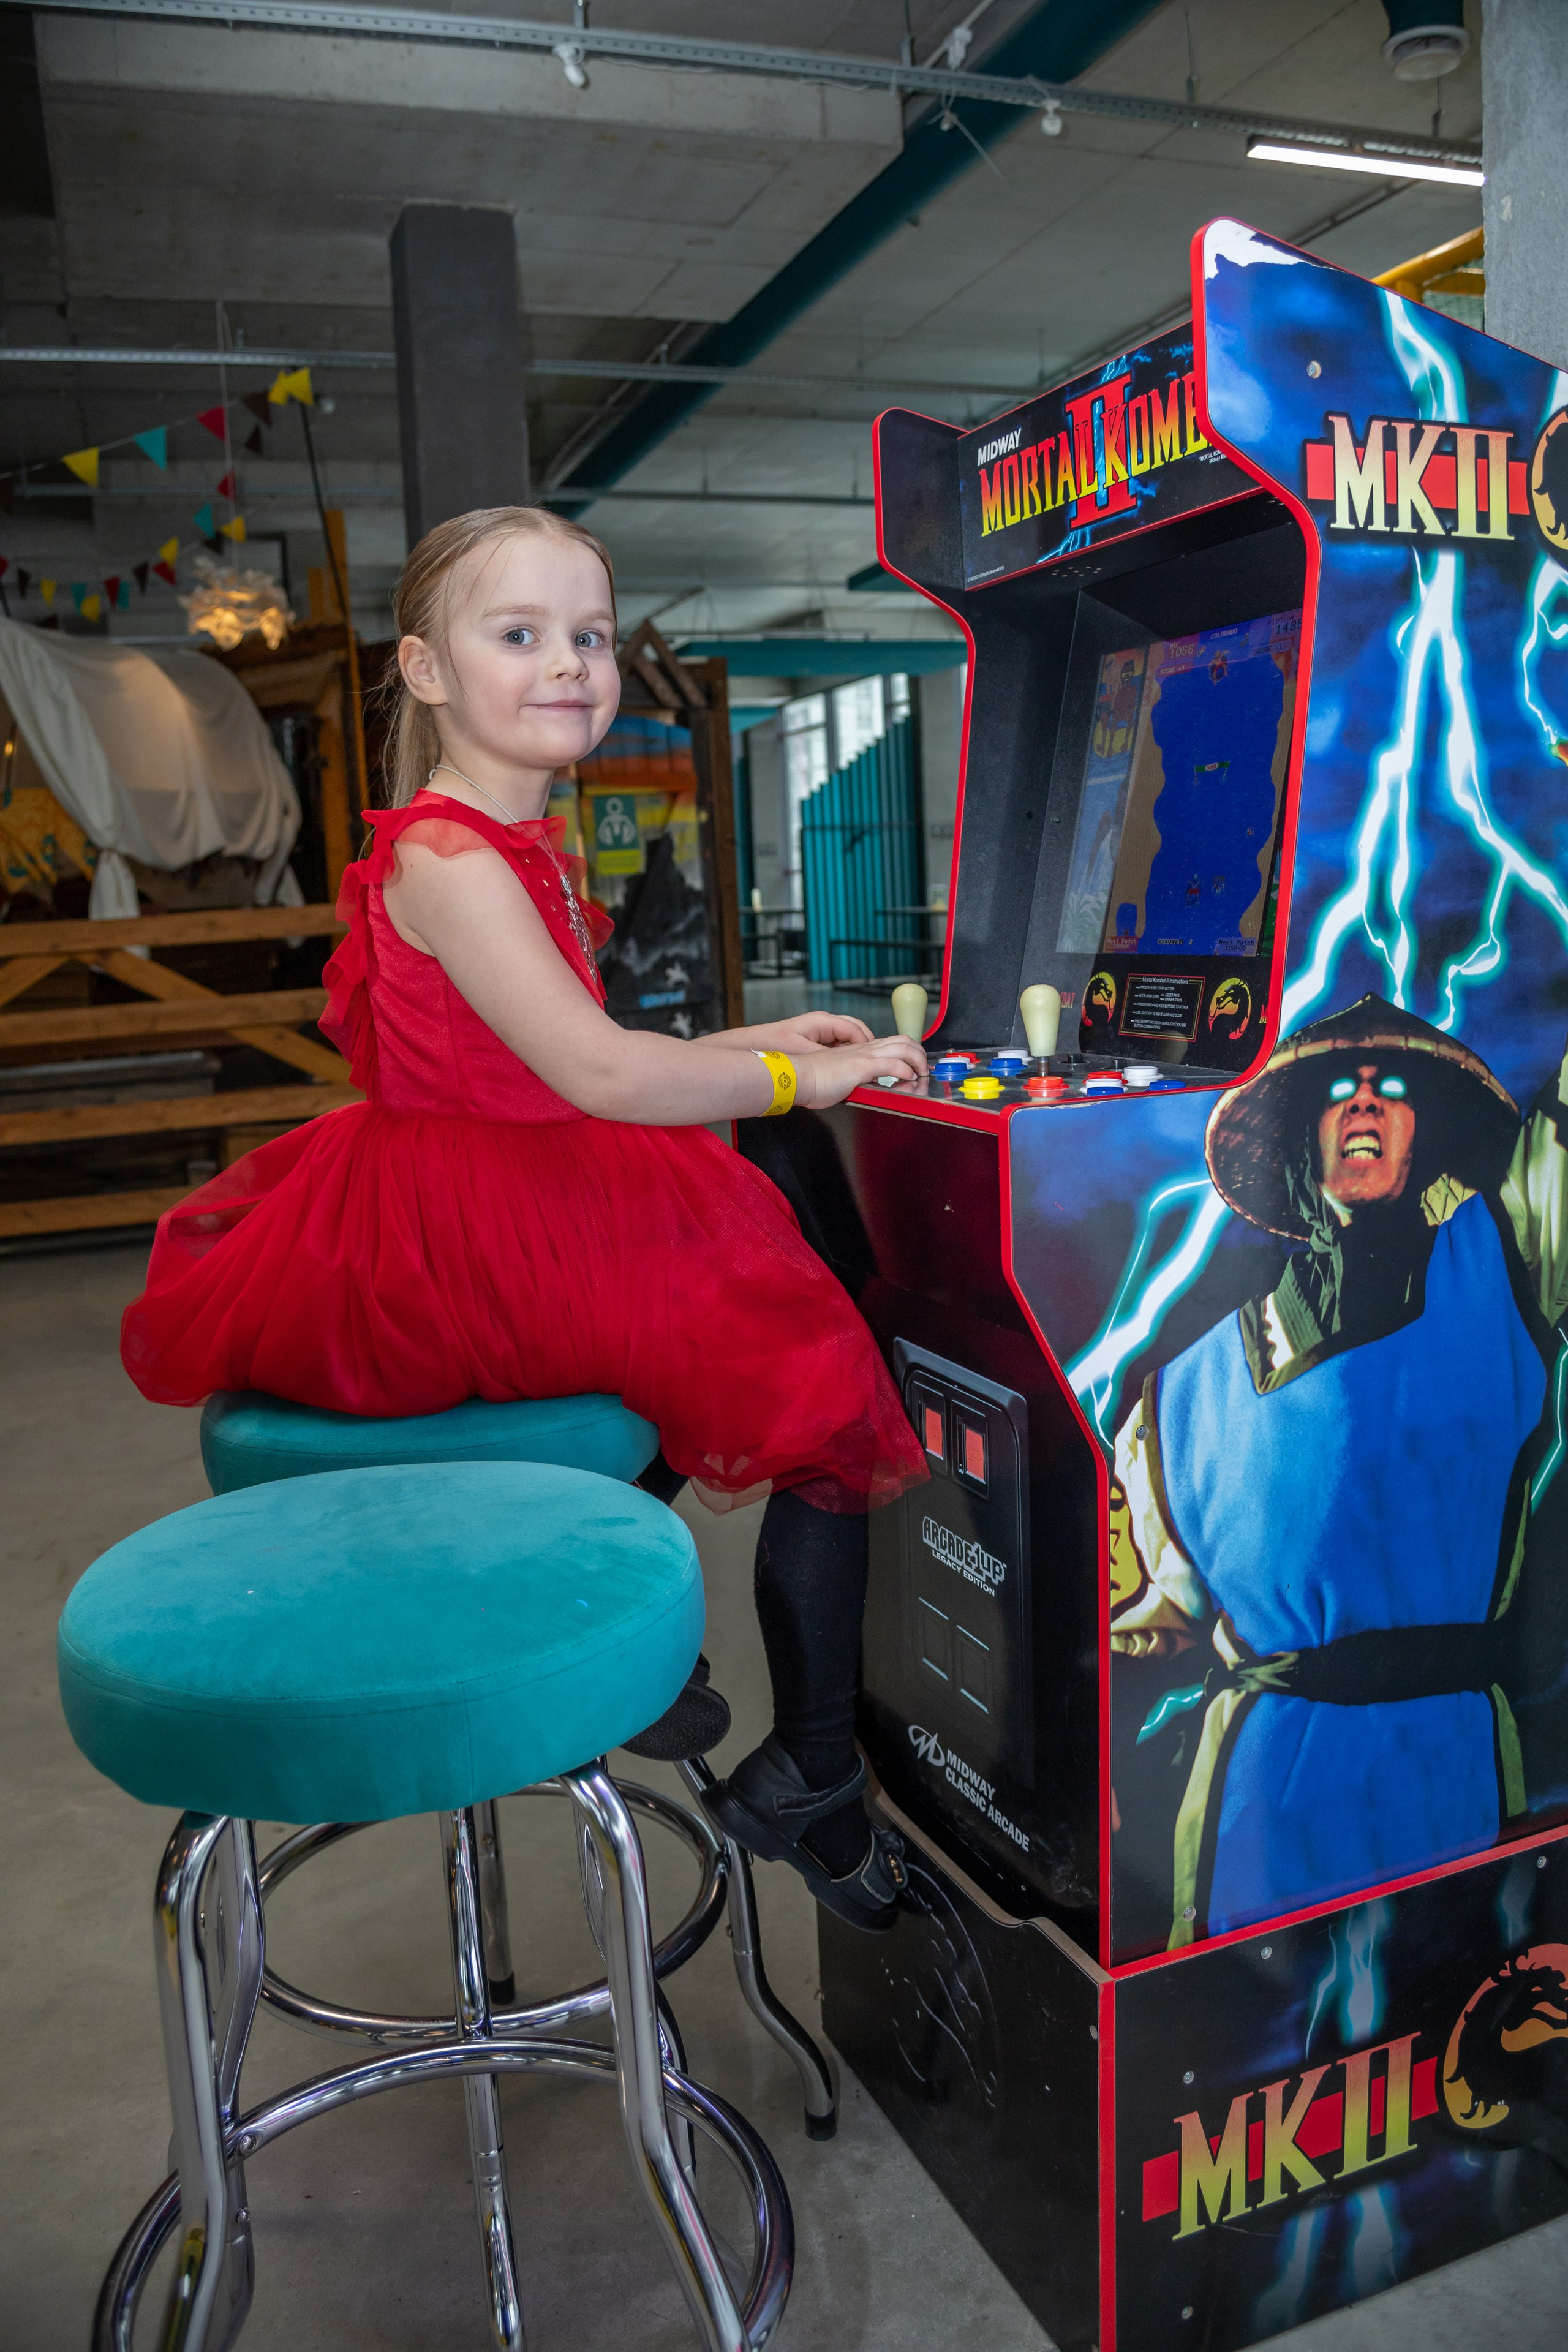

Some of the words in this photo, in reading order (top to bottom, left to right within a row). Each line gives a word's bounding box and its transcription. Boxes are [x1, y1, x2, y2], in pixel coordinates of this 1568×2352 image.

[978, 428, 1021, 466] MIDWAY
[979, 420, 1098, 537] MORTAL
[1101, 371, 1212, 488] KOMB
[1328, 416, 1515, 540] MKII
[1170, 644, 1194, 659] 1056
[1210, 628, 1238, 639] COLORADO
[1254, 646, 1272, 655] SCORE
[1160, 666, 1176, 675] SCORE
[932, 1549, 962, 1574] LEGACY
[963, 1569, 995, 1597] EDITION
[947, 1749, 996, 1801] MIDWAY
[945, 1766, 986, 1812] CLASSIC
[987, 1804, 1030, 1852] ARCADE
[1172, 2031, 1421, 2240] MKII
